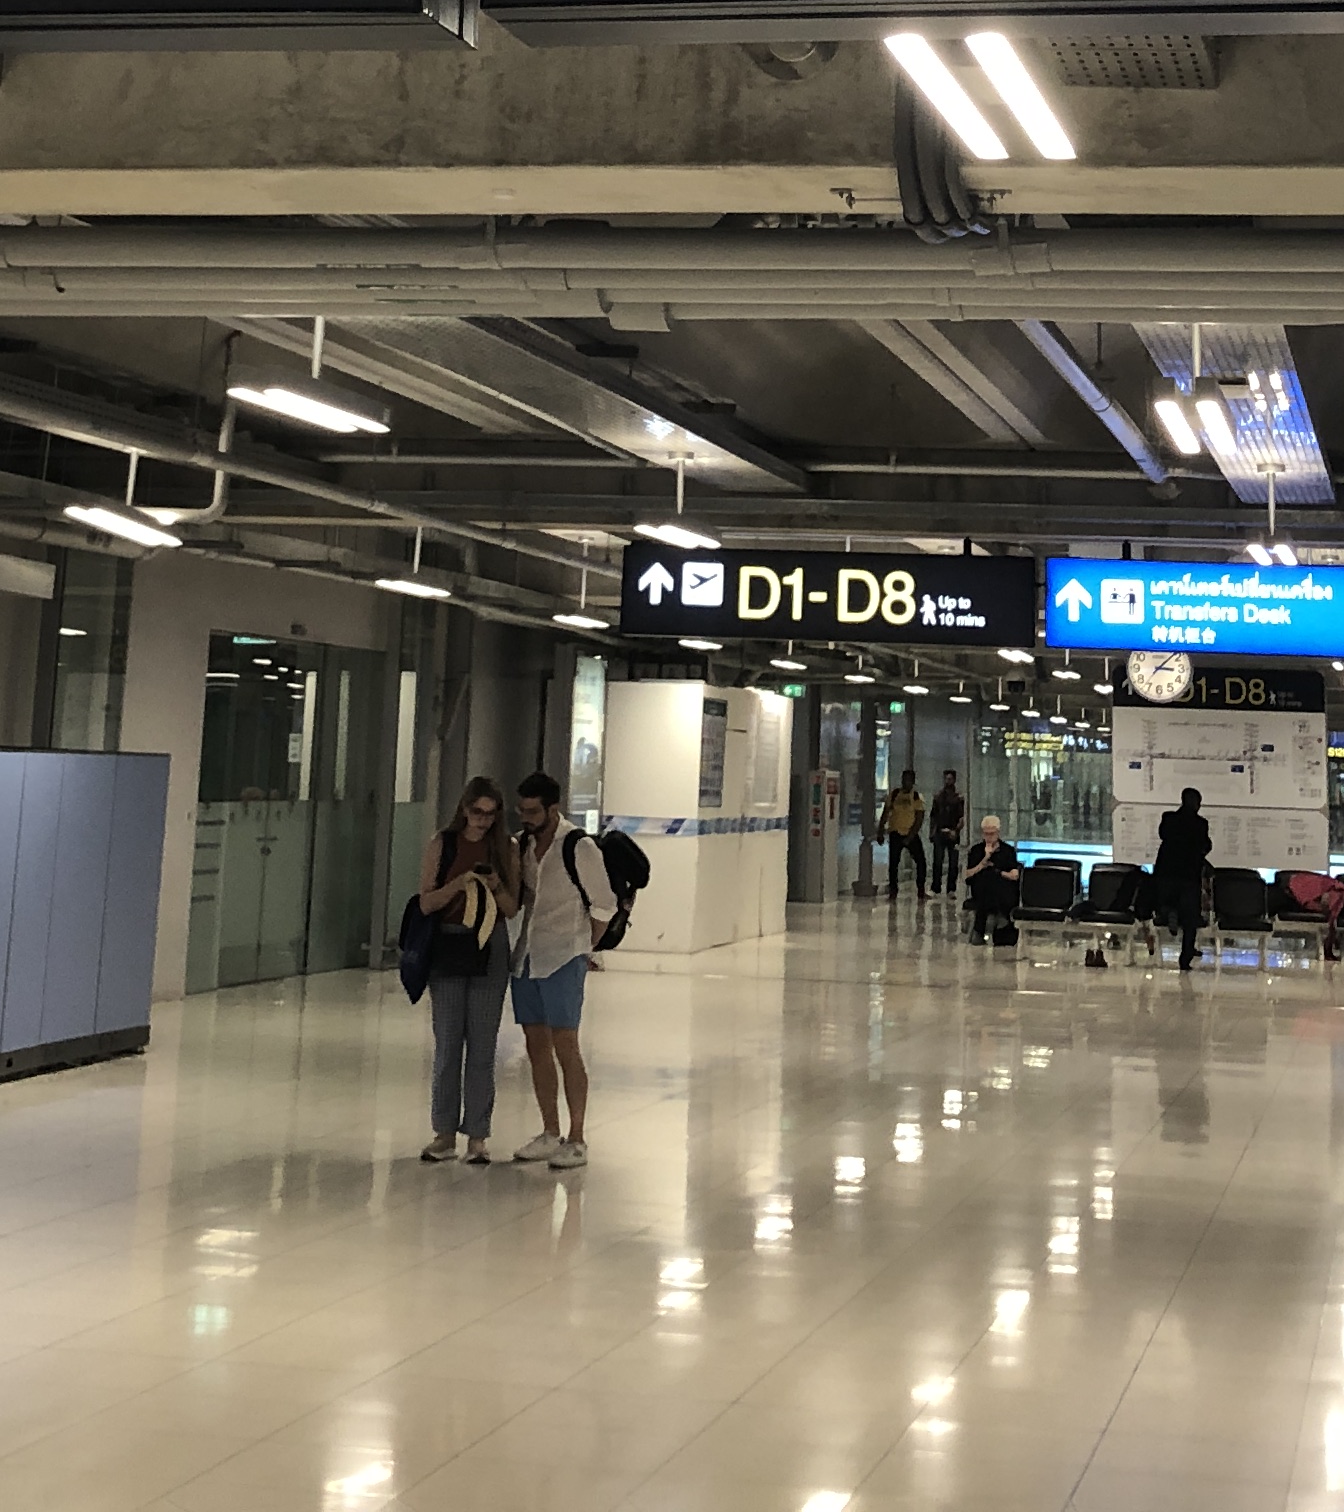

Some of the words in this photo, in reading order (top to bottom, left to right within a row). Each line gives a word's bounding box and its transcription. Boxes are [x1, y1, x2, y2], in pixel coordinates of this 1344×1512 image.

[938, 594, 956, 611] Up
[958, 596, 972, 610] to
[938, 612, 955, 627] 10
[956, 612, 986, 628] mins
[1150, 600, 1239, 623] Transfers
[1243, 603, 1292, 625] Desk
